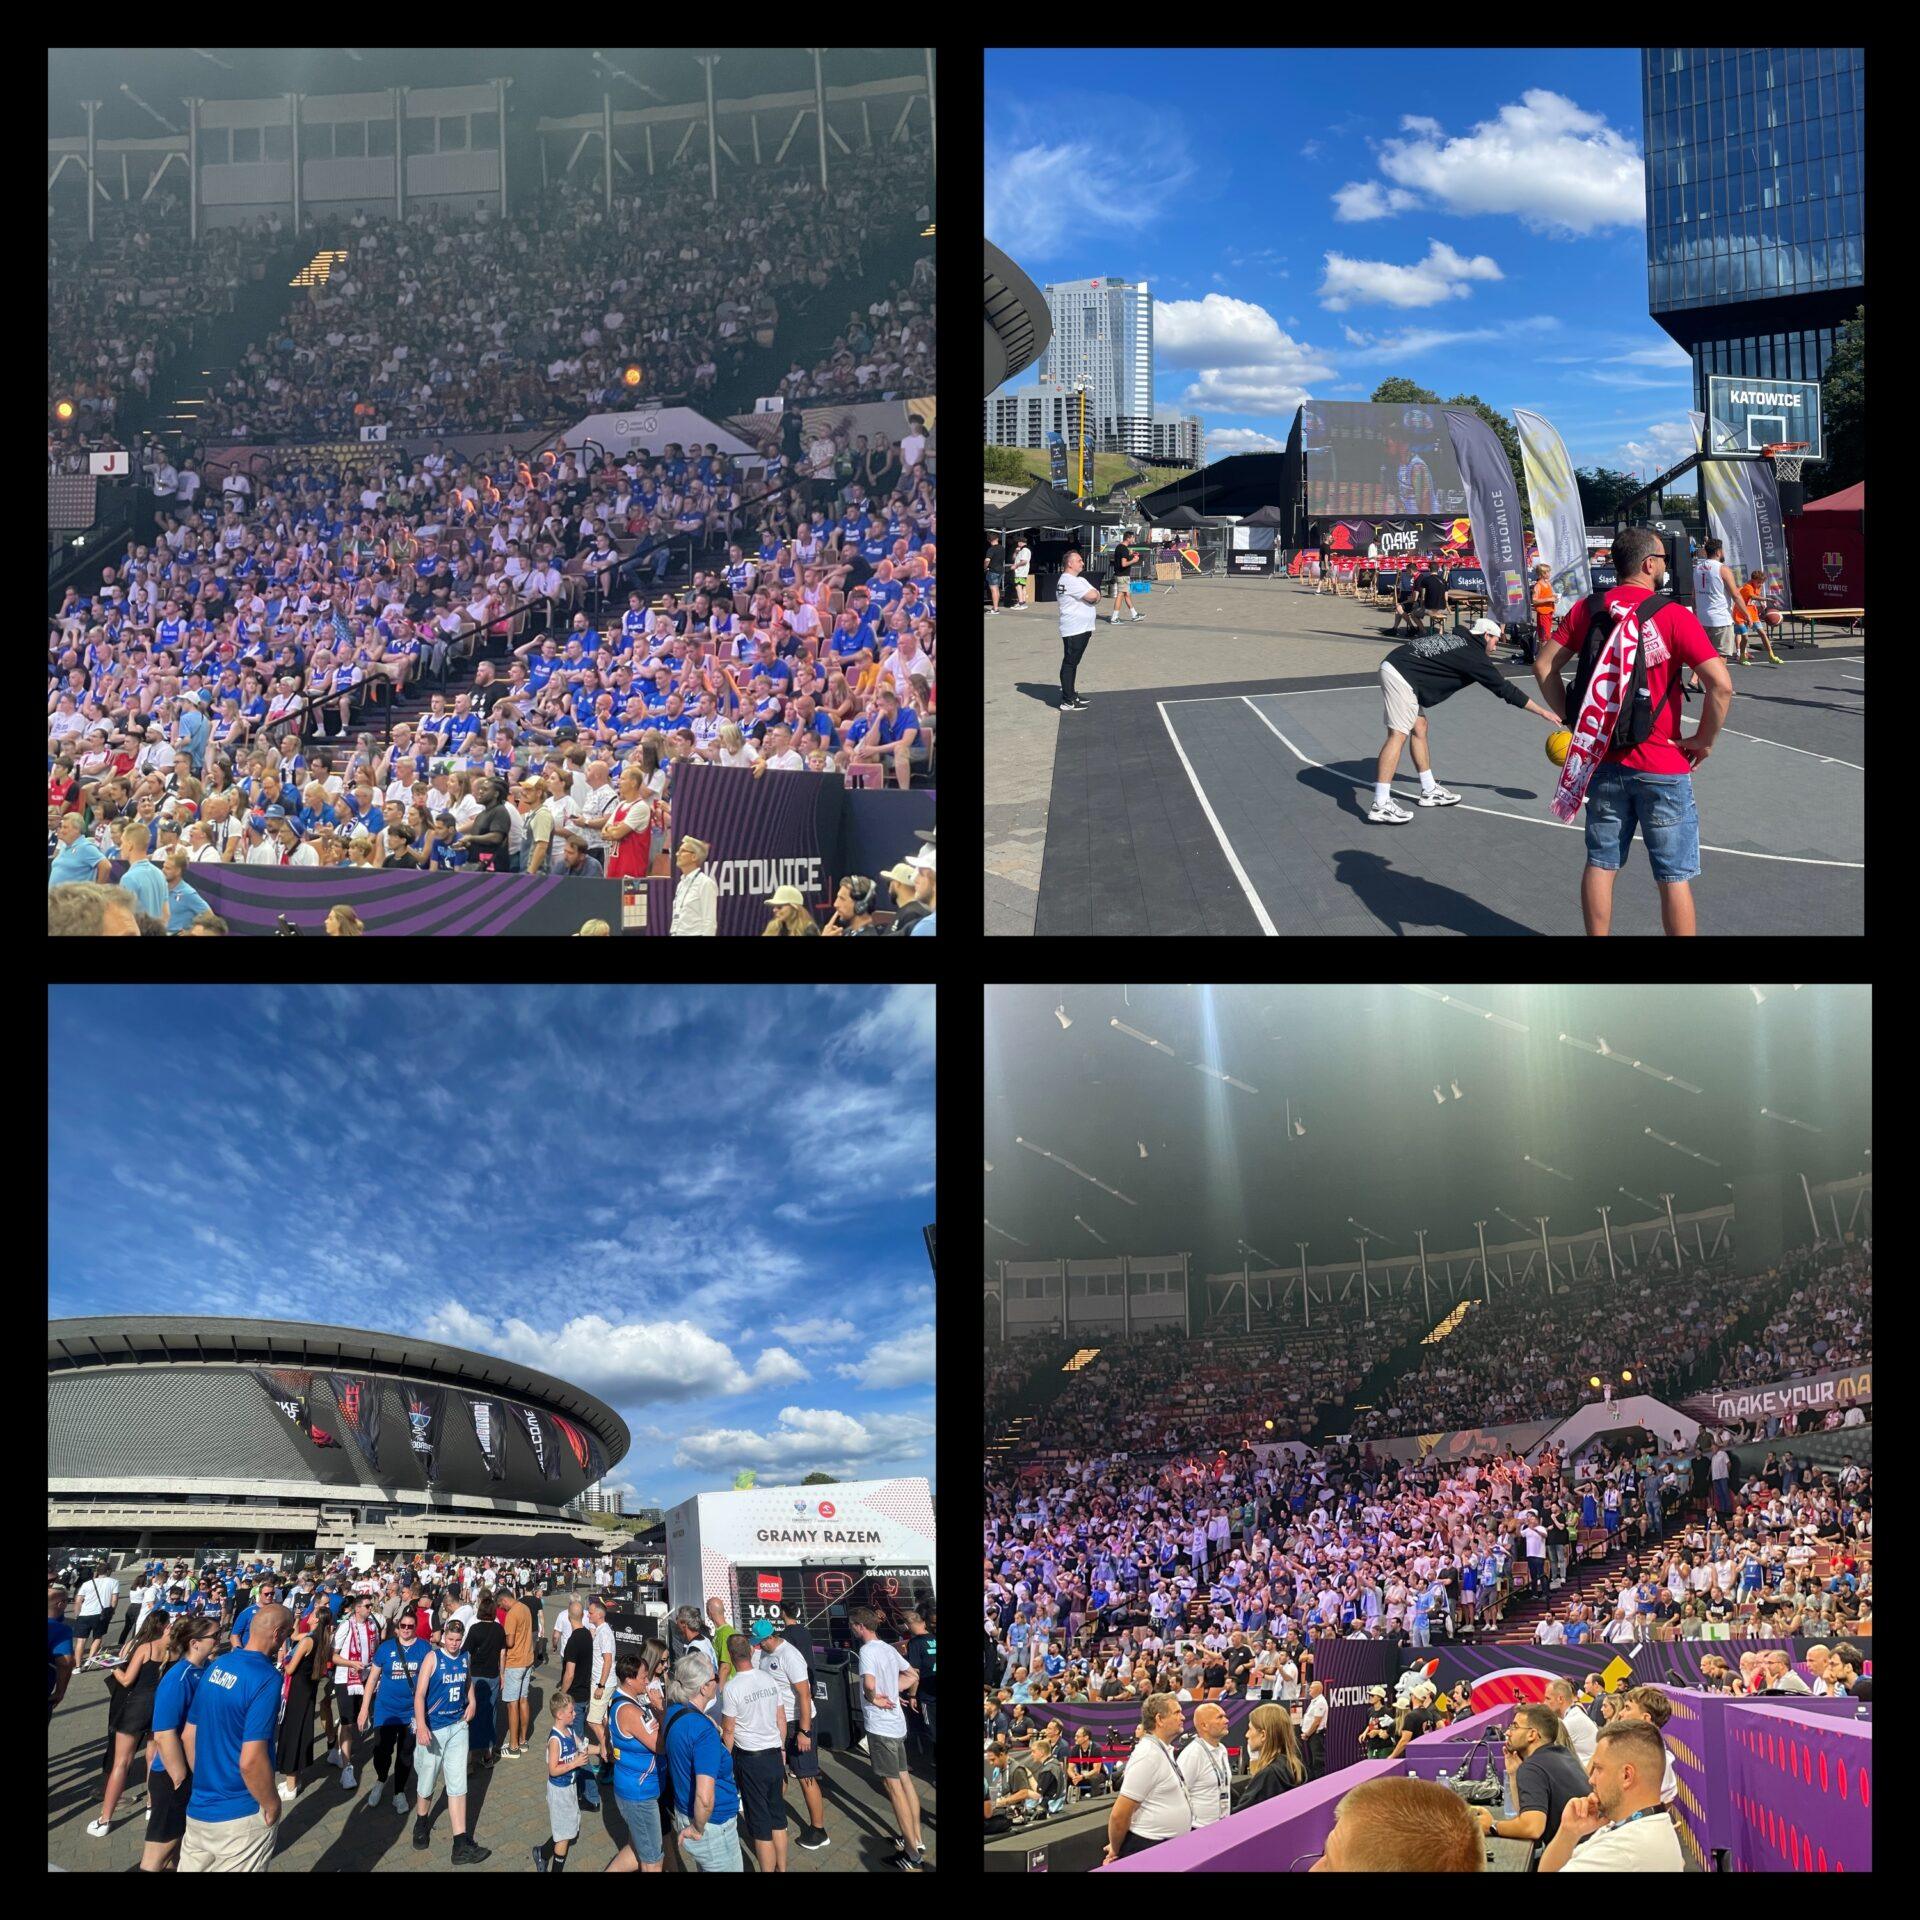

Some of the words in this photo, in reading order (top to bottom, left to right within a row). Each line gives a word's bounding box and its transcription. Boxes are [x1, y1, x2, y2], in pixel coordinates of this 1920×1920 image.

[1730, 390, 1802, 407] KATOWICE
[765, 400, 774, 412] L
[367, 427, 379, 440] K
[103, 454, 115, 472] J
[1381, 530, 1419, 543] MAKE
[1599, 575, 1617, 583] Śląsk
[1817, 583, 1849, 593] KATOWICE
[704, 857, 823, 897] KATOWICE
[1718, 1391, 1776, 1419] MAKE
[1779, 1381, 1834, 1408] YOUR
[1581, 1466, 1591, 1478] K
[756, 1529, 818, 1543] GRAMY
[823, 1530, 881, 1543] RAZEM
[865, 1569, 897, 1577] GRAMY
[899, 1569, 930, 1577] RAZEM
[748, 1604, 767, 1618] 14
[1710, 1626, 1722, 1640] L
[391, 1661, 418, 1671] ÍSLND
[208, 1665, 238, 1690] ÍSLAND
[442, 1672, 467, 1684] ÍSLAND
[448, 1686, 461, 1703] 15
[1329, 1684, 1388, 1708] KATOW
